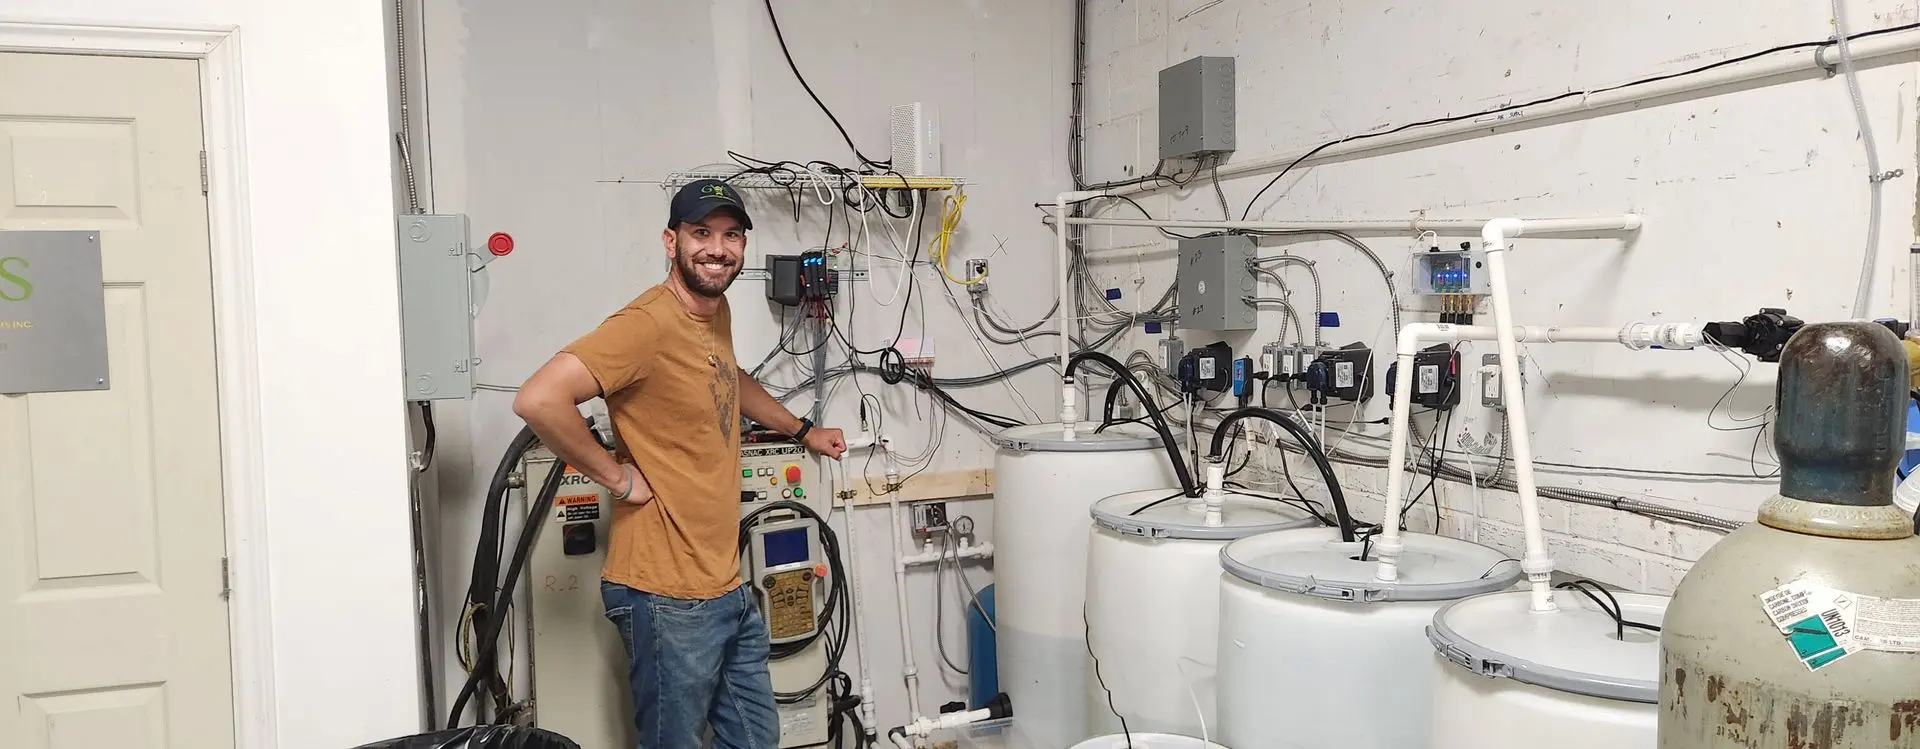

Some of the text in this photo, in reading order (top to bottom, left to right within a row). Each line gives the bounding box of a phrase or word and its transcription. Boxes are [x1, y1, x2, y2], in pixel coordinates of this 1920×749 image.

[766, 447, 779, 456] XRC
[782, 446, 803, 455] UP20
[566, 495, 596, 504] WARNING
[1821, 608, 1851, 638] UN1013
